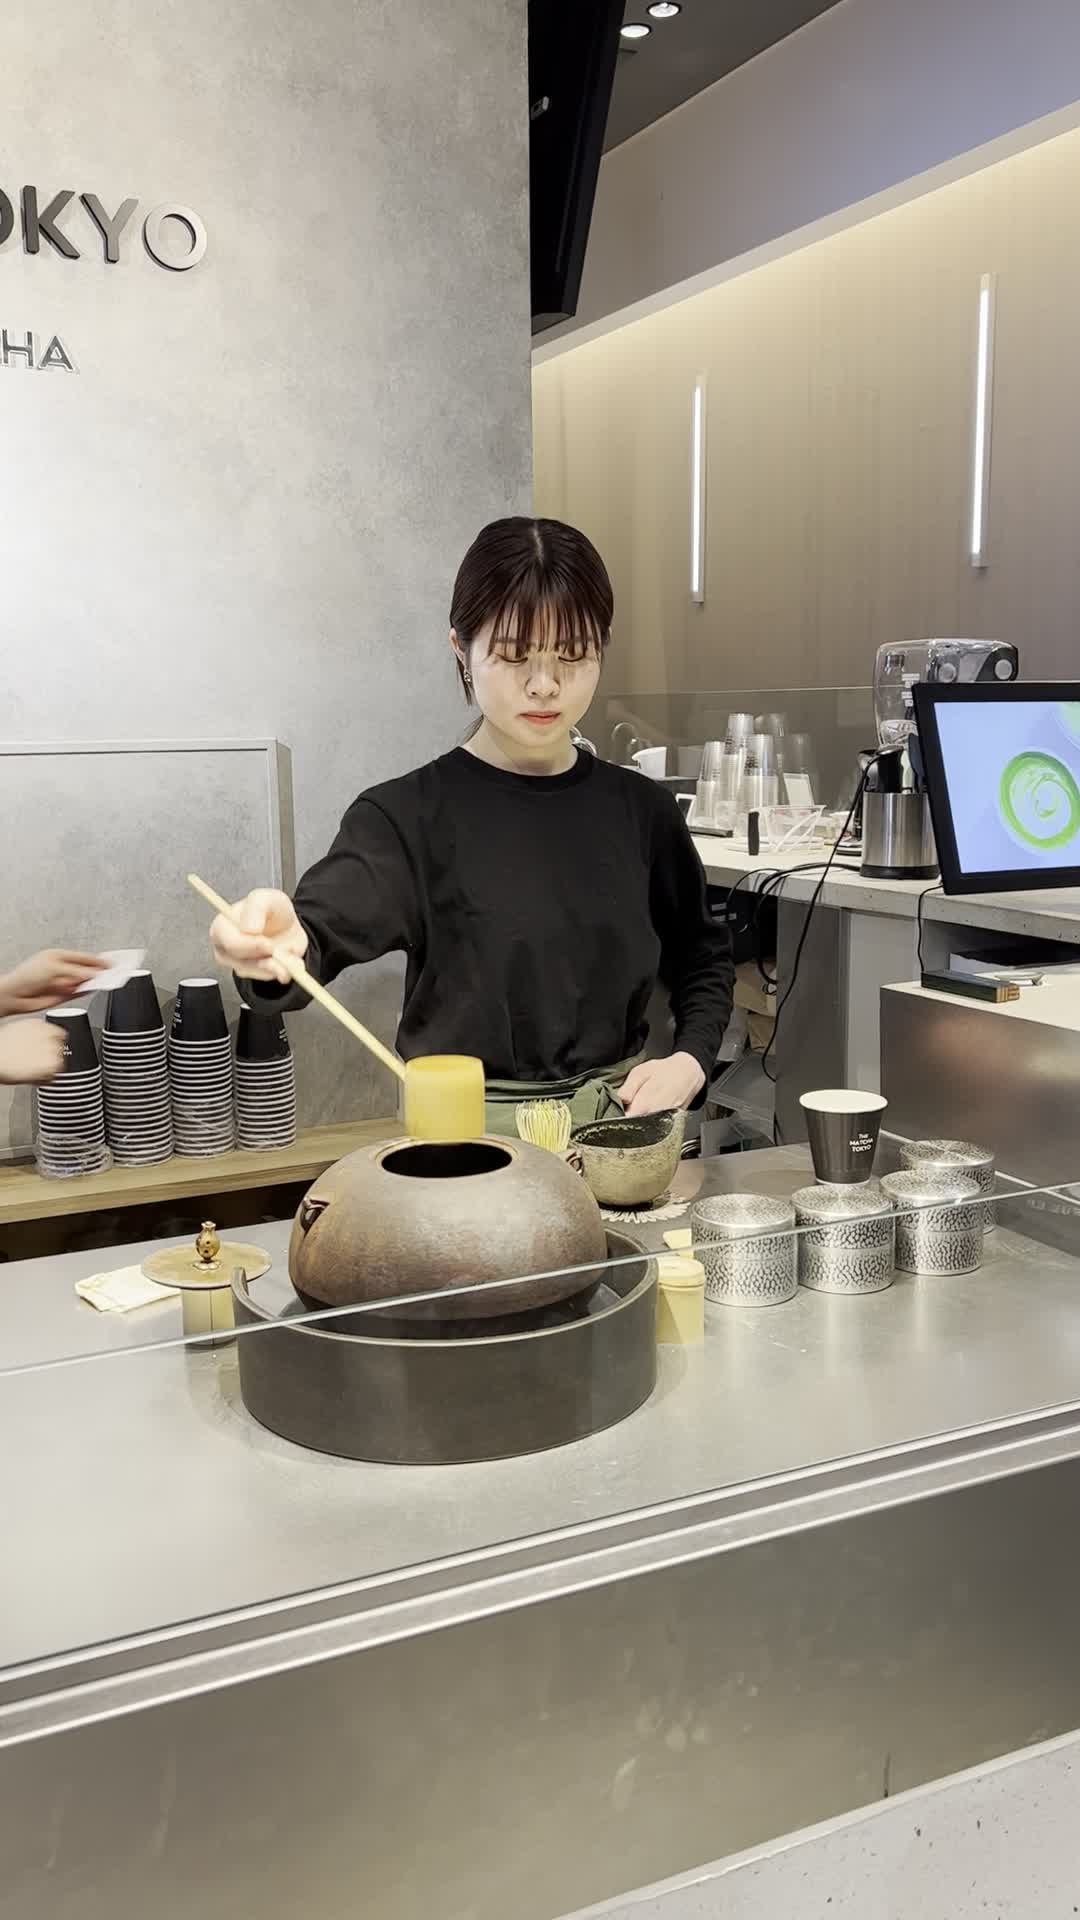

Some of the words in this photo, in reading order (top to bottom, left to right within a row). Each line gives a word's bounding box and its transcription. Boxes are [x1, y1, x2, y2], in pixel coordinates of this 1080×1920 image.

[0, 184, 207, 272] KYO
[849, 1138, 873, 1146] MATCHA
[852, 1144, 872, 1152] TOKYO
